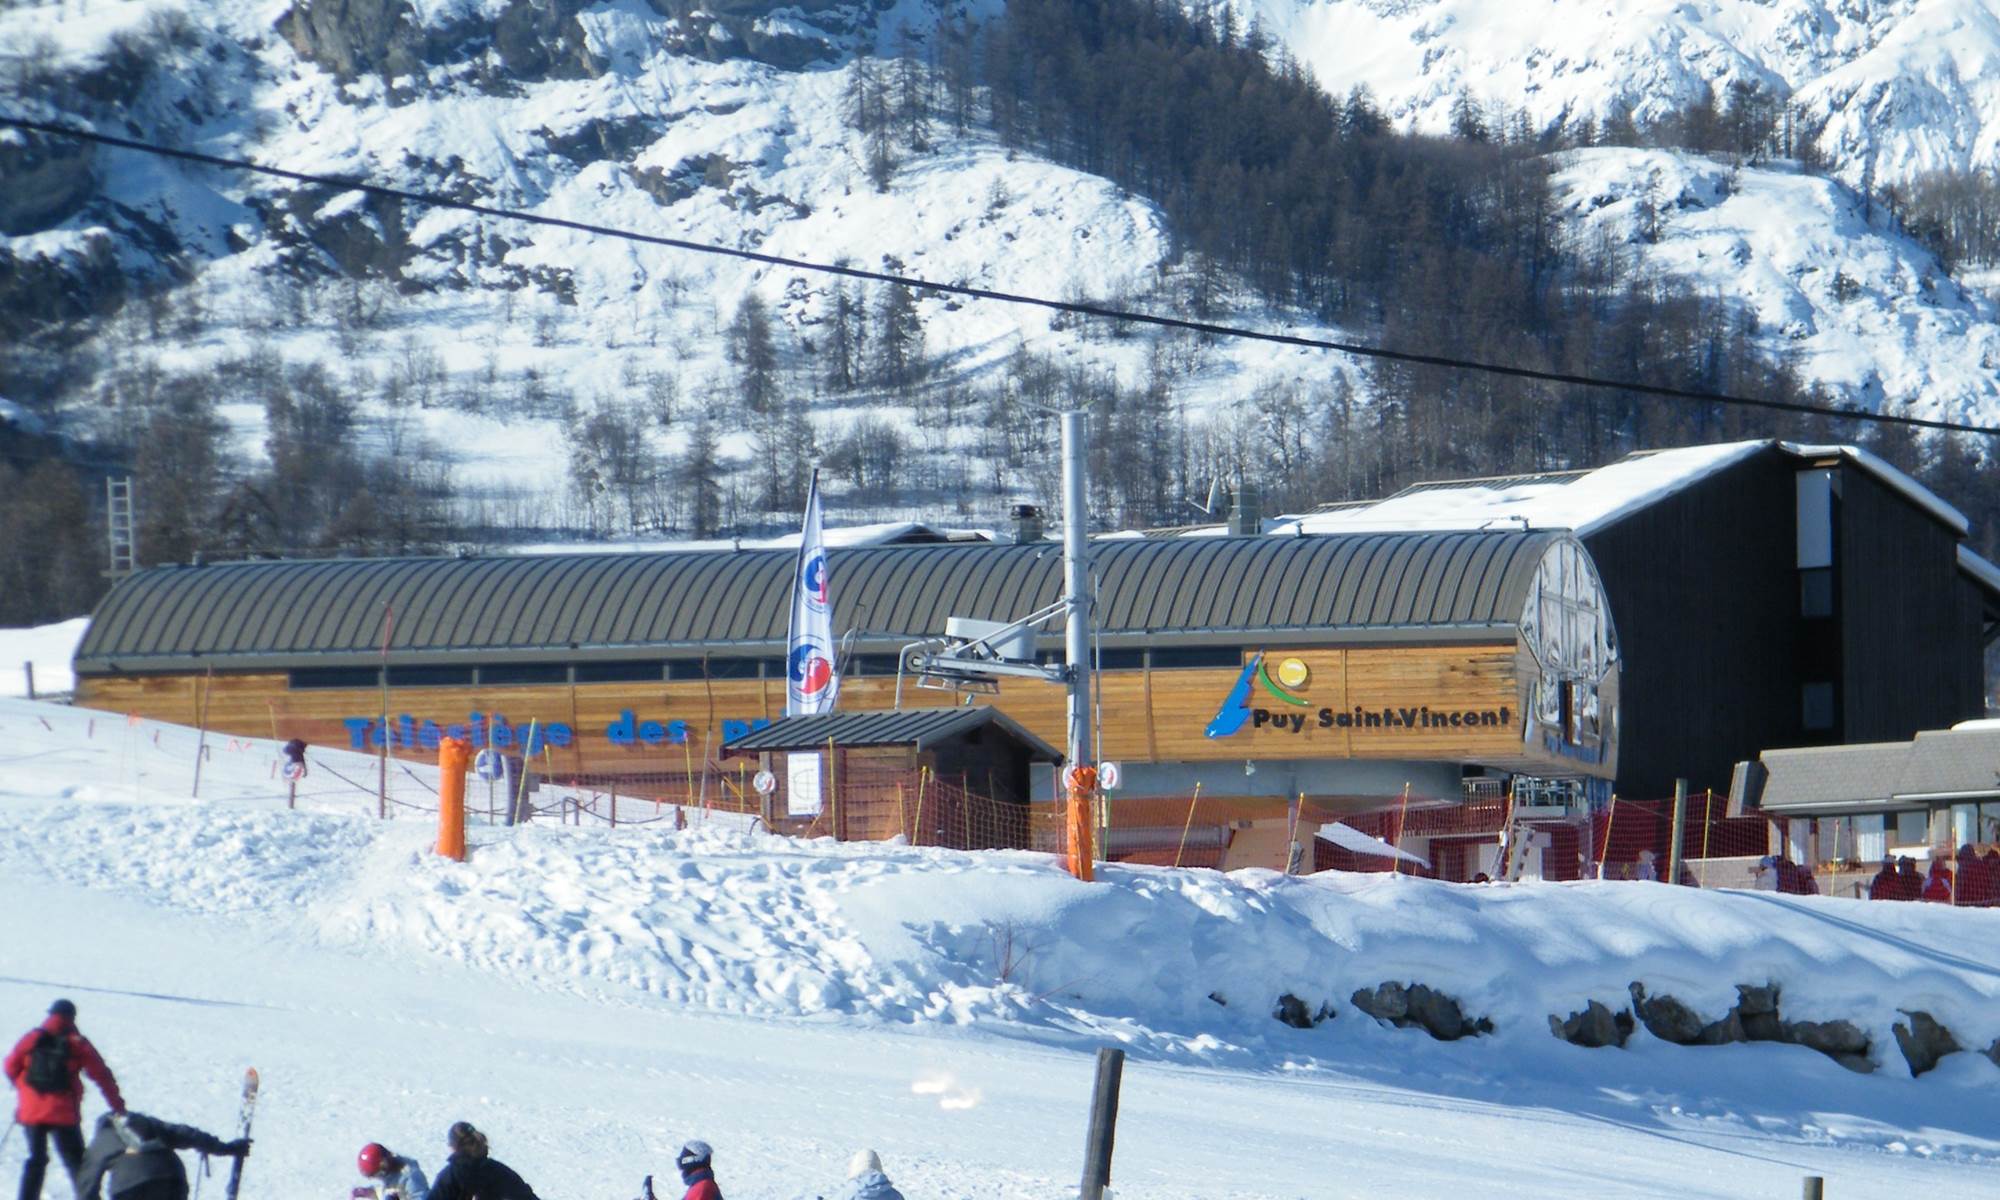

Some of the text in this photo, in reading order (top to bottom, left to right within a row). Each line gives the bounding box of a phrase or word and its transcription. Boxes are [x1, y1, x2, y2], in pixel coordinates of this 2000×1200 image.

[607, 709, 687, 745] des
[1253, 706, 1510, 733] Puy Saint-Vincent
